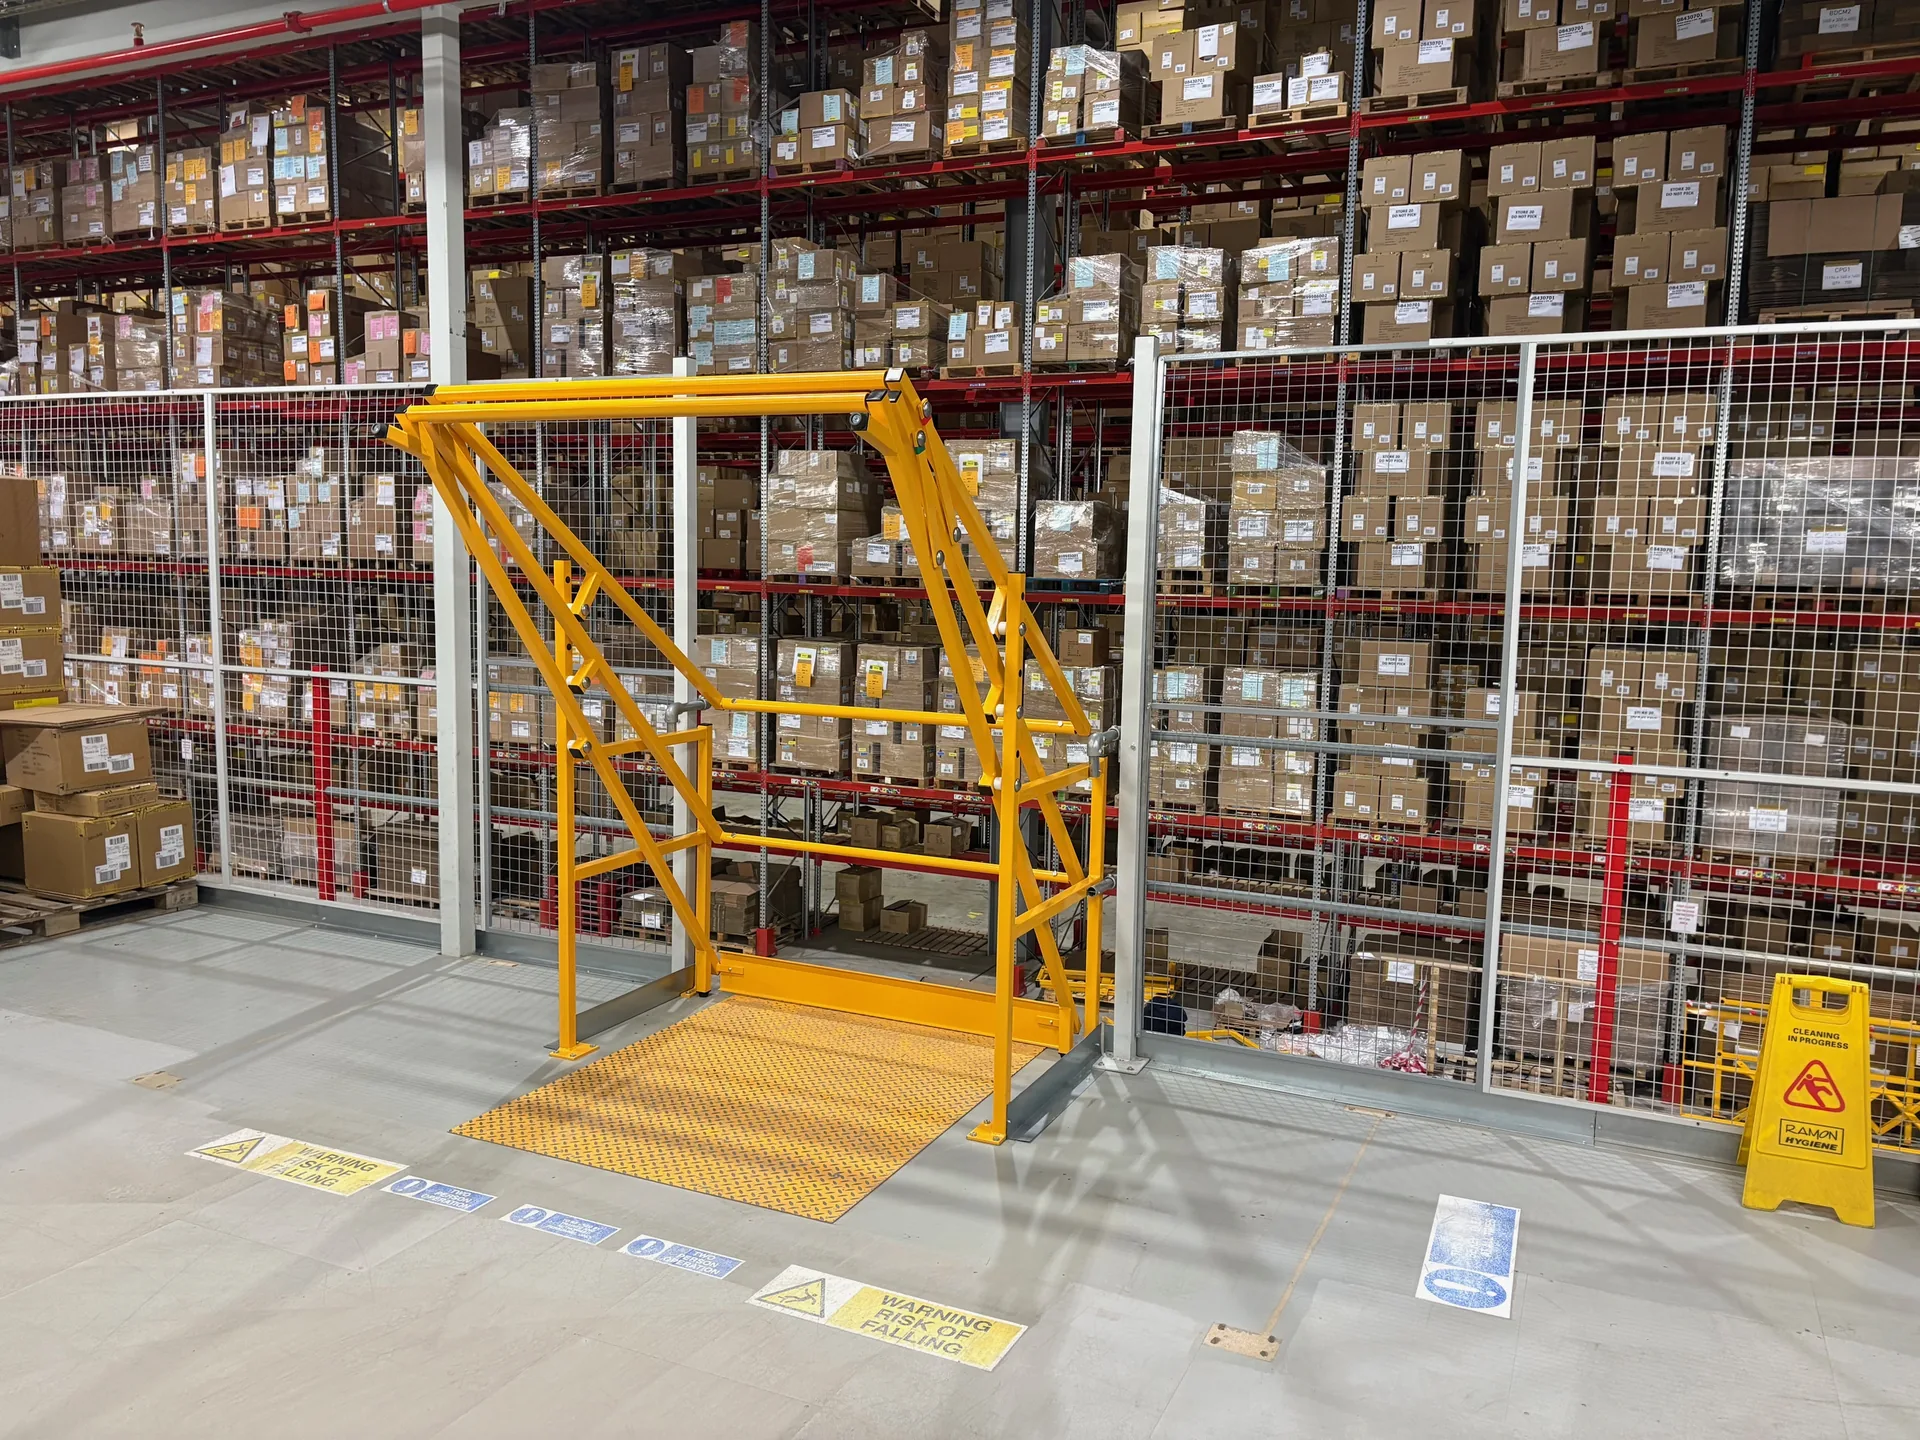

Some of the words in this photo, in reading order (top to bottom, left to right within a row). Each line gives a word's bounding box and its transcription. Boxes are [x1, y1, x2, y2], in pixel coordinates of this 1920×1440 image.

[1793, 1028, 1840, 1040] CLEANING
[1800, 1036, 1848, 1050] PROGRESS
[1786, 1124, 1838, 1140] RAMON
[1786, 1136, 1838, 1151] HYGIENE
[284, 1156, 326, 1171] RISK
[326, 1167, 356, 1177] OF
[296, 1147, 378, 1172] WARNING
[266, 1163, 339, 1187] FALLING
[420, 1194, 472, 1209] OPERATION
[434, 1192, 473, 1204] PERSON
[676, 1254, 719, 1268] PERSON
[693, 1251, 716, 1260] TWO
[664, 1256, 720, 1275] OPERATION
[881, 1294, 993, 1332] WARNING
[874, 1308, 934, 1332] RISK
[937, 1326, 974, 1340] OF
[860, 1320, 963, 1355] FALLING
